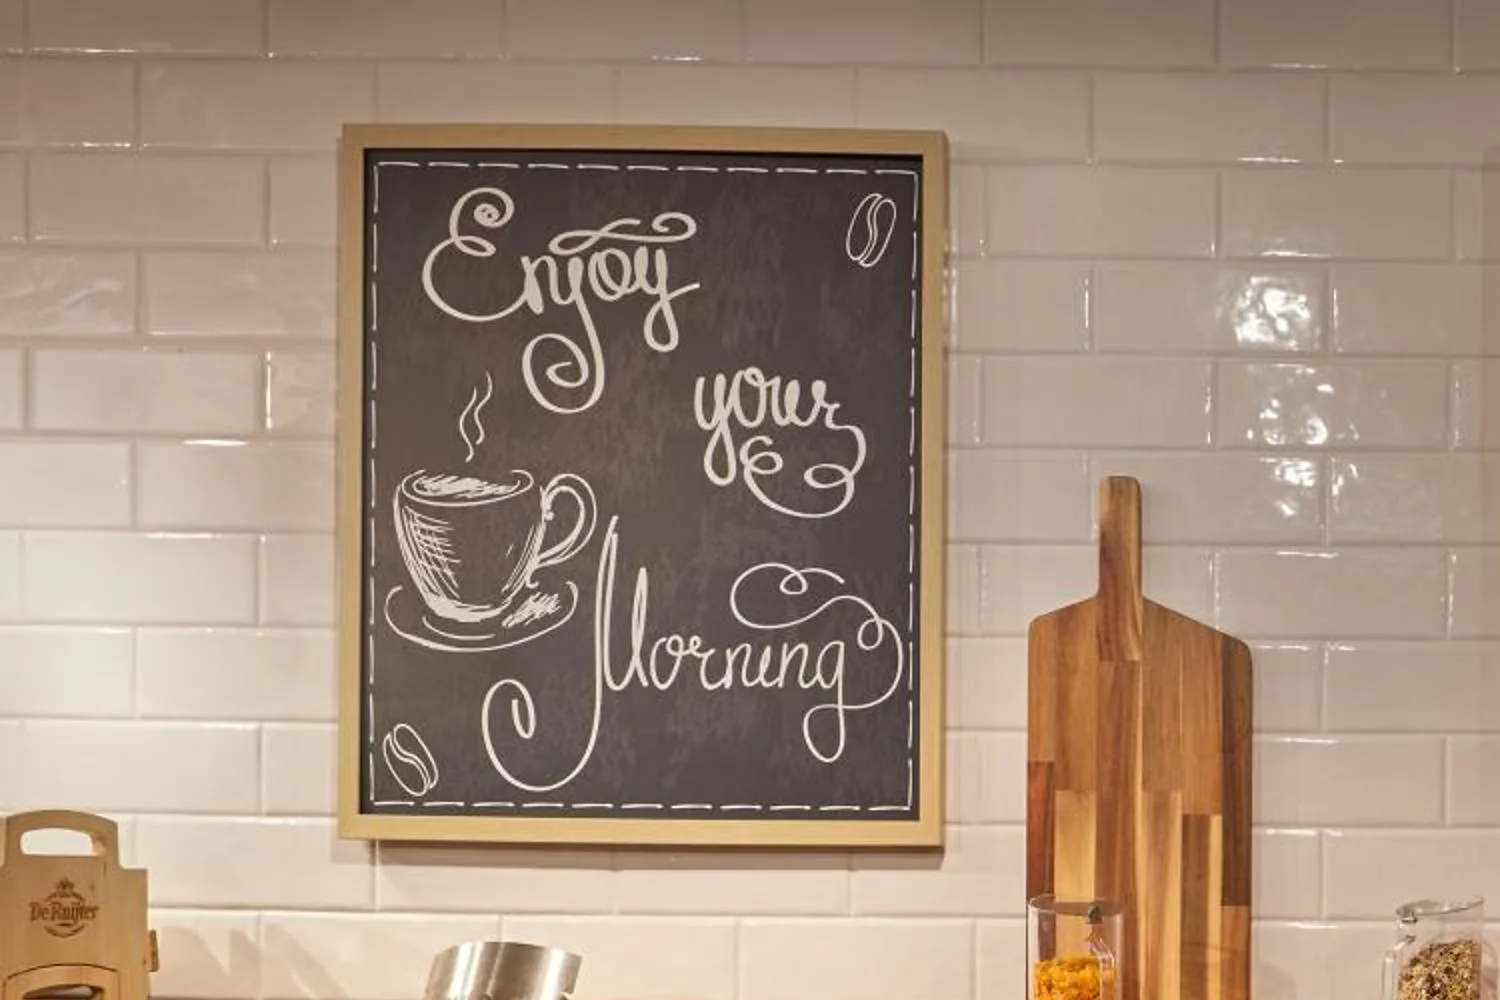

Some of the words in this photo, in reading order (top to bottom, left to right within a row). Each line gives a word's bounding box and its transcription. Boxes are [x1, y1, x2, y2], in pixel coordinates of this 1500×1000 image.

[422, 187, 699, 414] Enjoy
[694, 367, 867, 518] your
[482, 515, 903, 791] Morning
